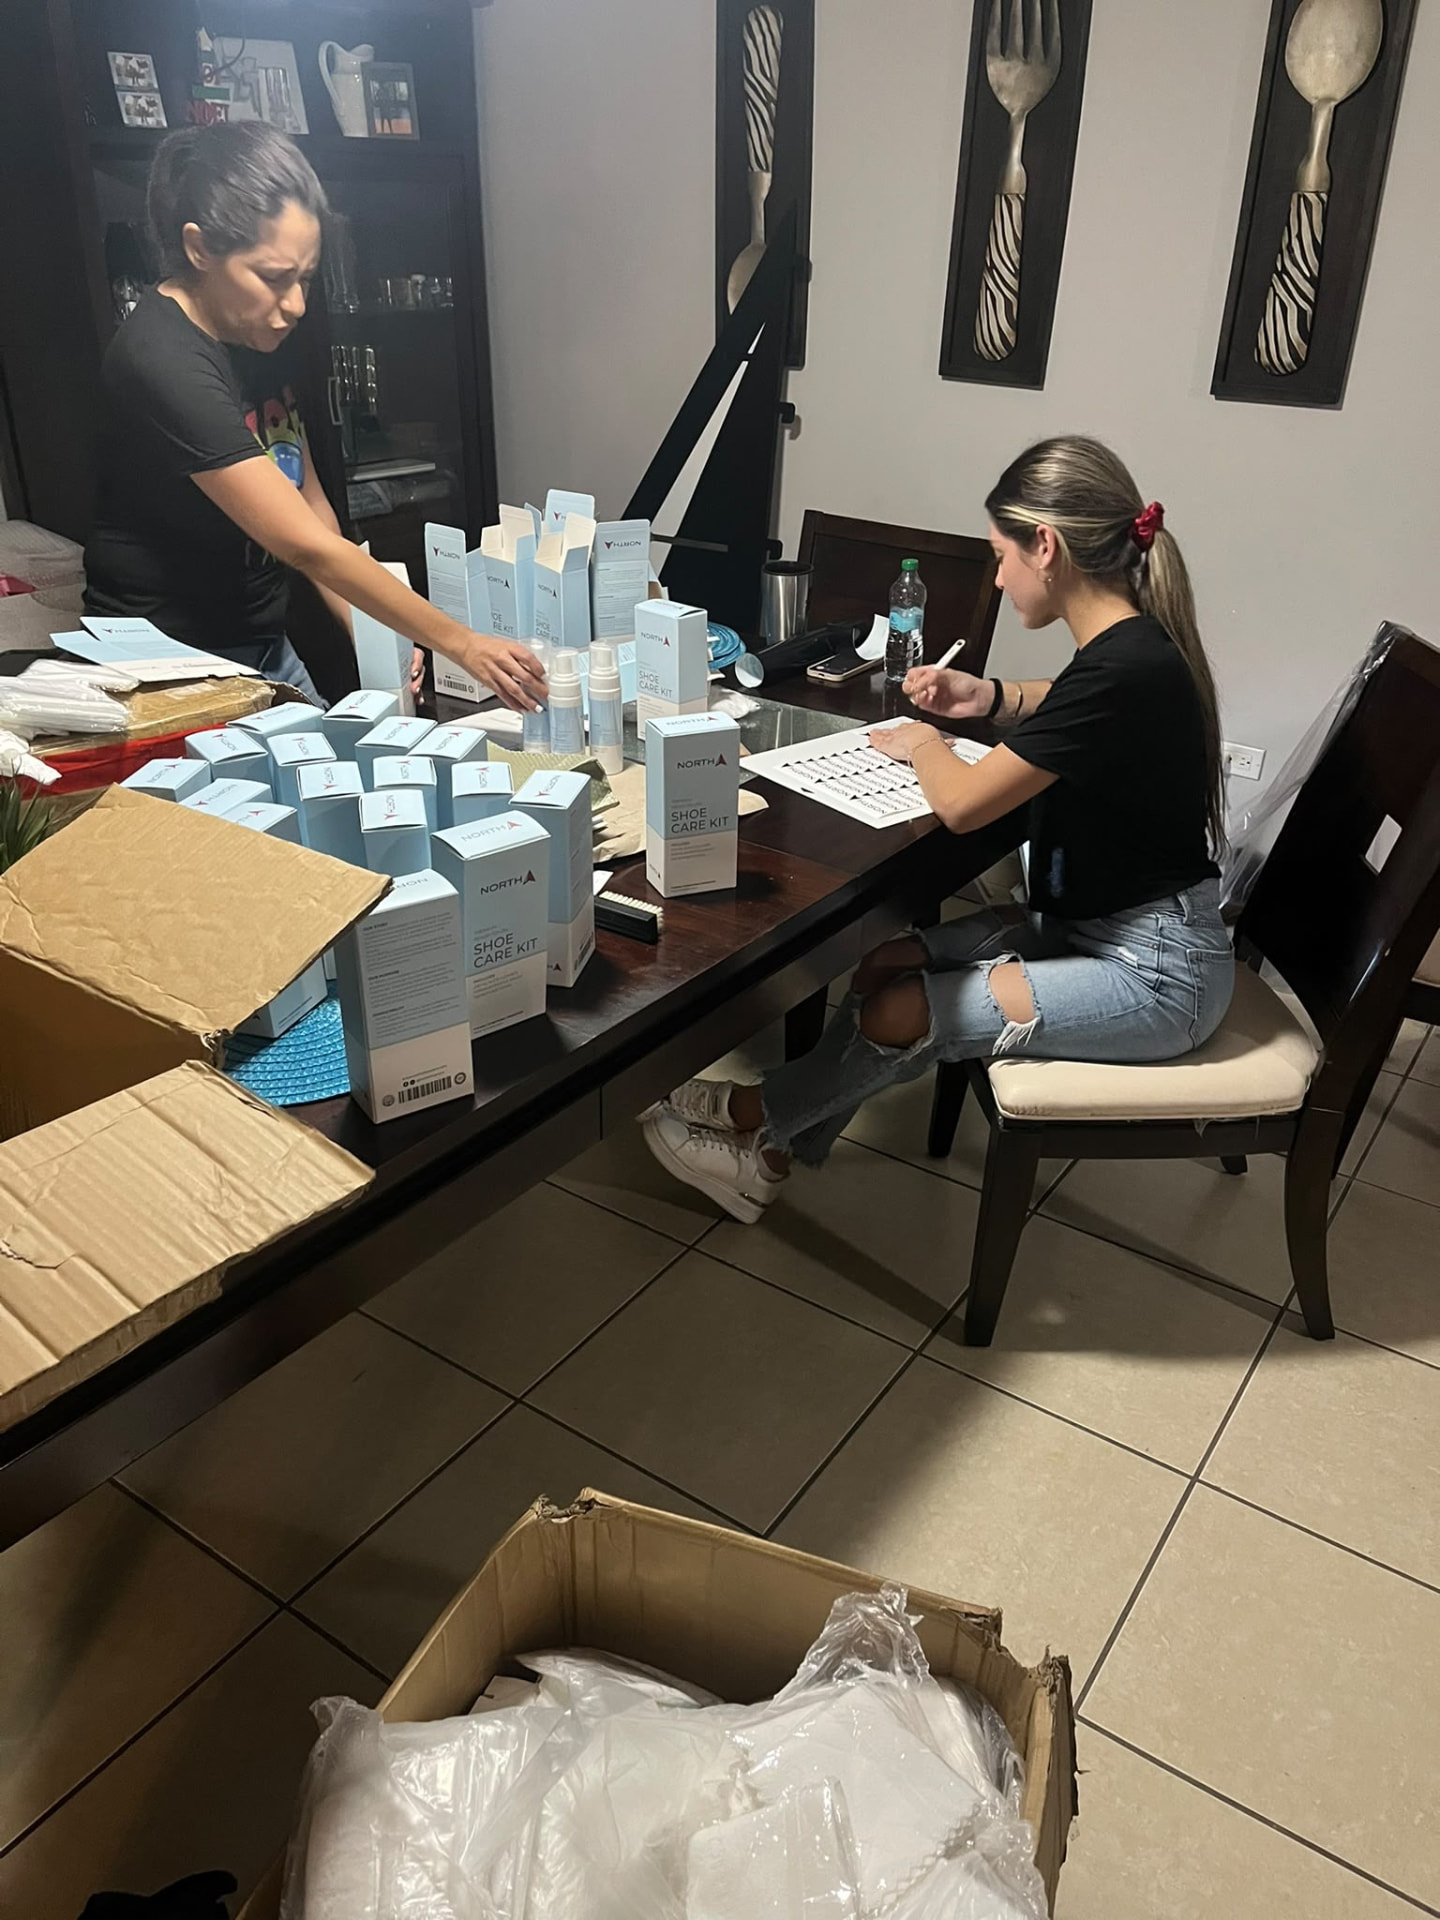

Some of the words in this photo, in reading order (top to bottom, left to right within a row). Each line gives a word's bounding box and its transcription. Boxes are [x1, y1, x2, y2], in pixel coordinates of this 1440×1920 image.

[640, 632, 663, 642] NORTH
[639, 670, 659, 685] SHOE
[639, 681, 659, 694] CARE
[660, 689, 673, 699] KIT
[677, 758, 715, 769] NORTH
[671, 807, 708, 822] SHOE
[671, 819, 706, 833] CARE
[710, 816, 729, 829] KIT
[460, 825, 507, 842] NORTH
[480, 876, 523, 895] NORTH
[474, 932, 514, 955] SHOE
[473, 946, 513, 968] CARE
[517, 937, 538, 954] KIT
